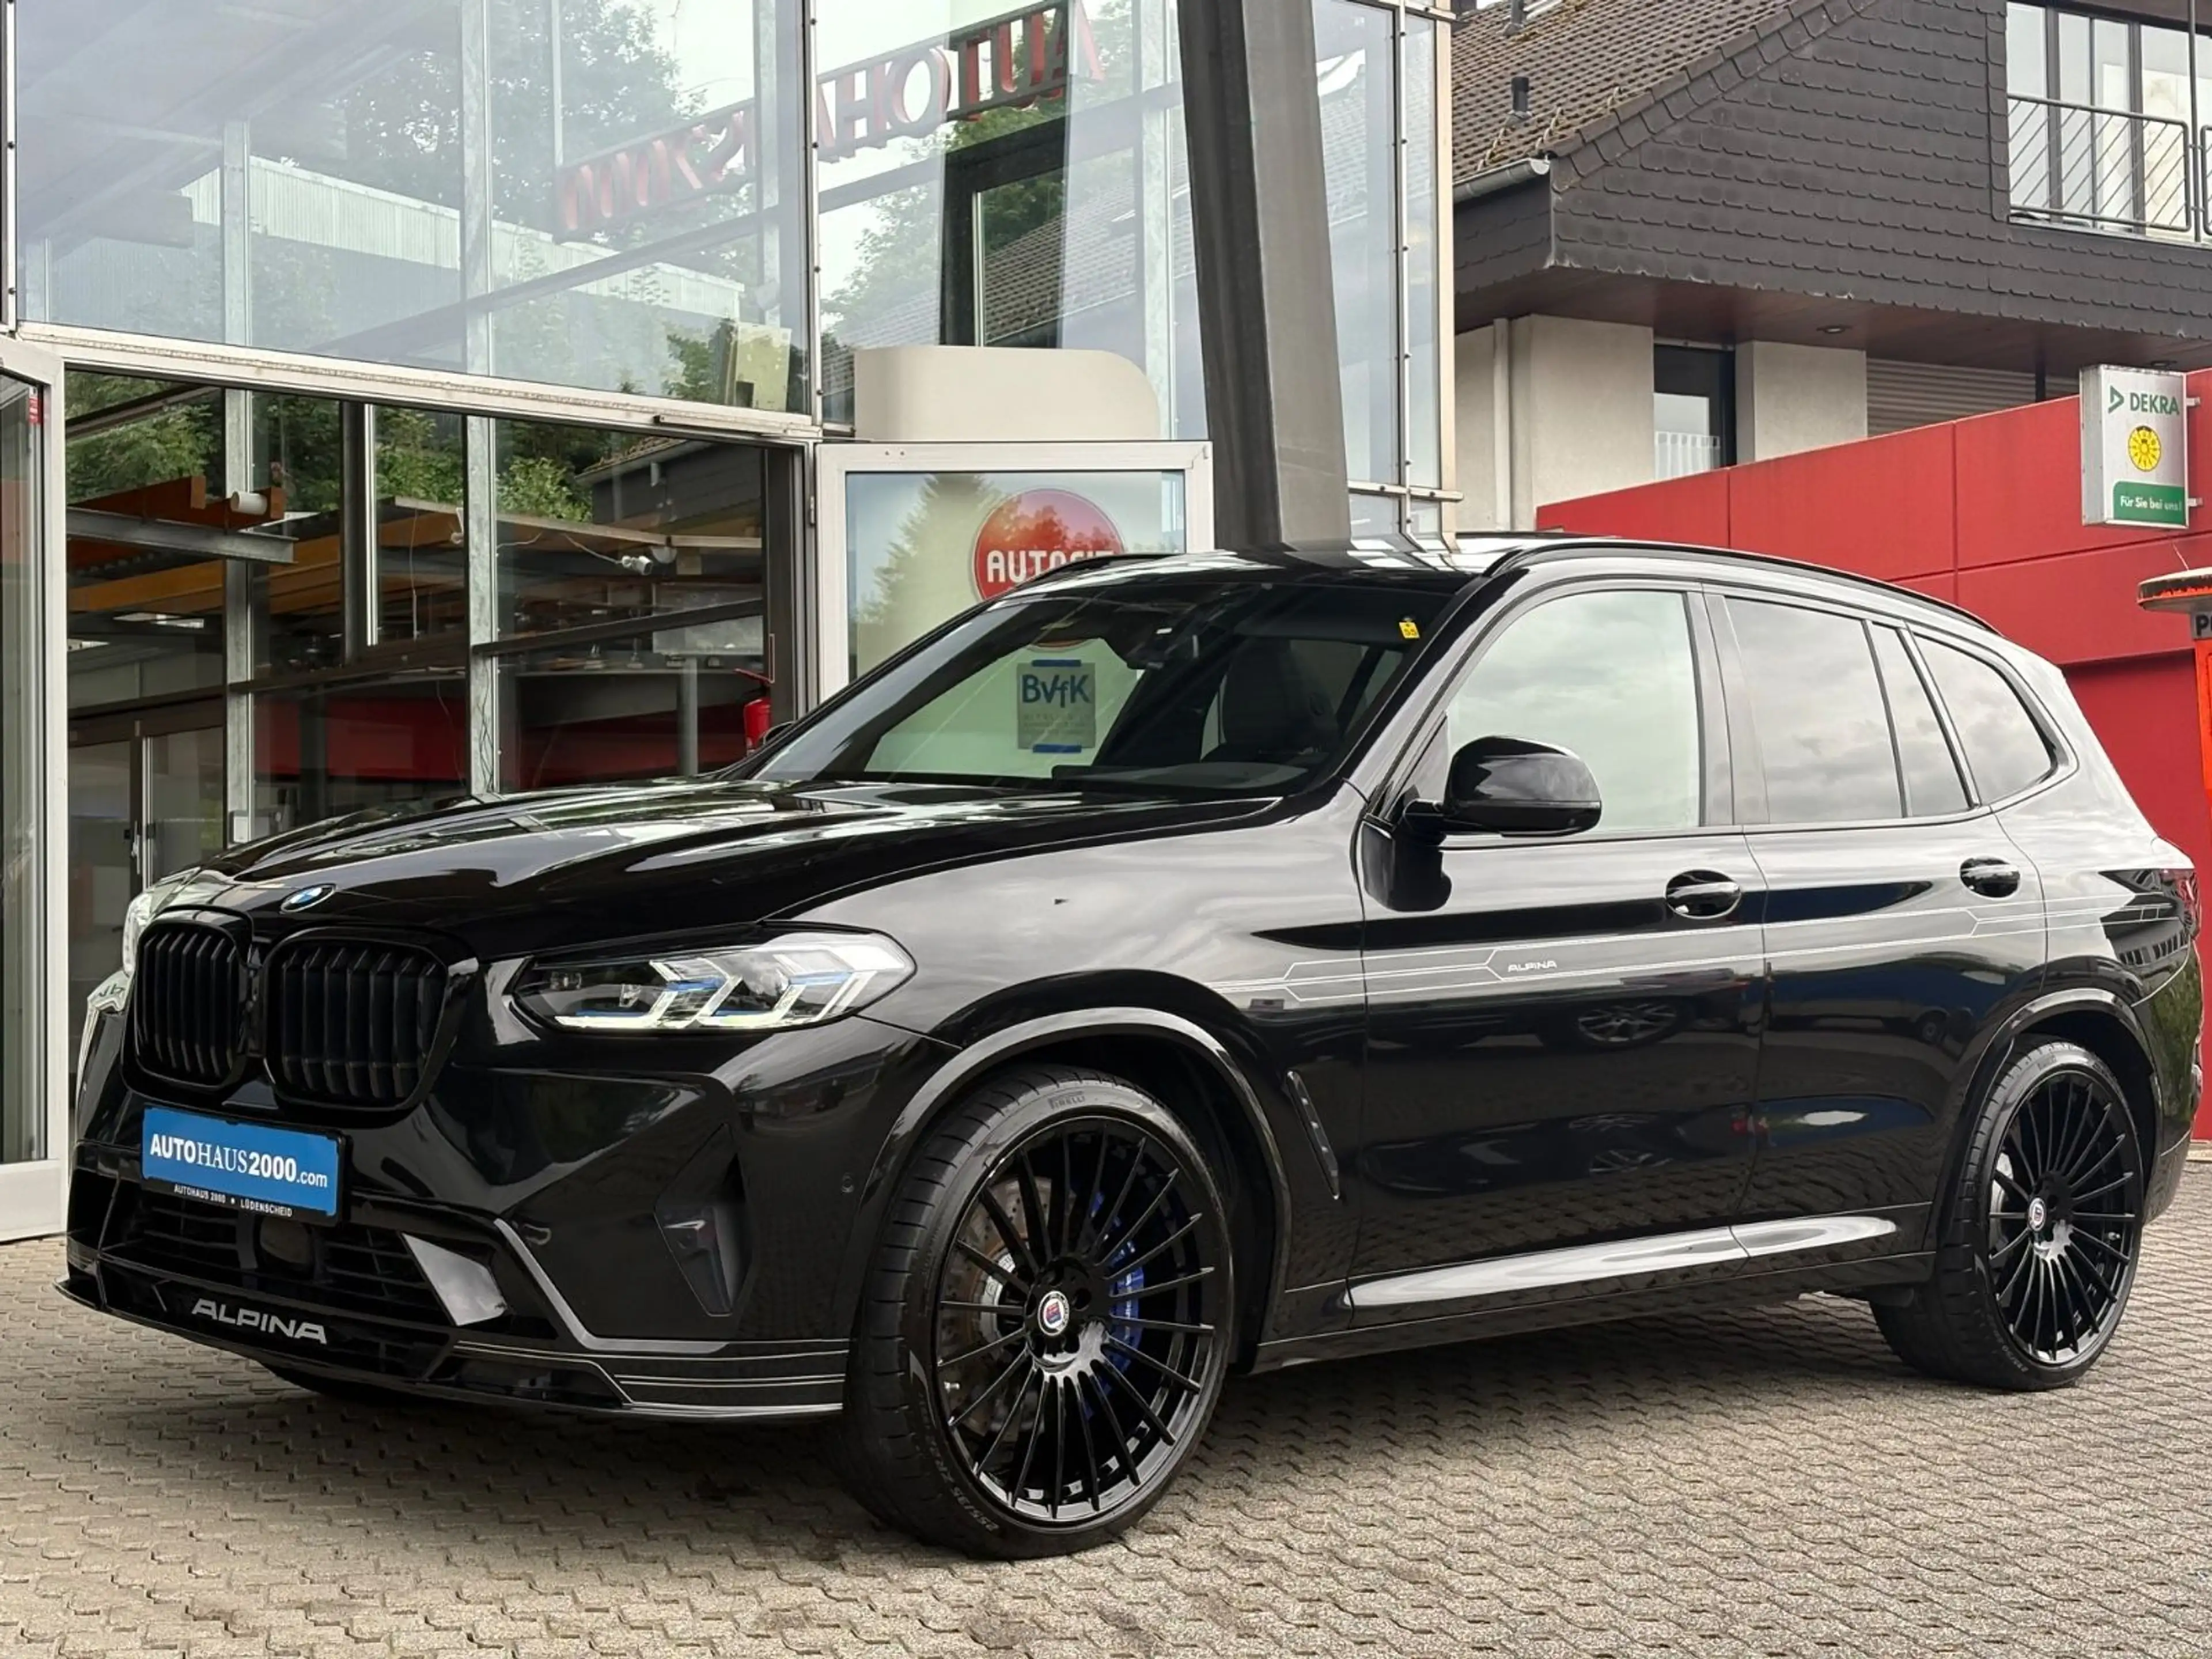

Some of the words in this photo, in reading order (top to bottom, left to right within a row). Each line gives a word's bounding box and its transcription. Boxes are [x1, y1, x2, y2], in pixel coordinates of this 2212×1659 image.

[2130, 392, 2180, 415] DEKRA
[2120, 495, 2134, 507] Für
[2135, 497, 2148, 508] Sie
[2149, 497, 2163, 509] bei
[2164, 501, 2182, 511] uns!
[987, 550, 1113, 583] AUTO
[1508, 960, 1558, 972] ALPINA
[150, 1133, 328, 1188] AUTOHAUS2000.com
[174, 1183, 209, 1200] AUTOHAUS
[210, 1192, 226, 1204] 2000
[240, 1198, 293, 1217] LÜDENSCHEID
[192, 1298, 327, 1344] ALPINA
